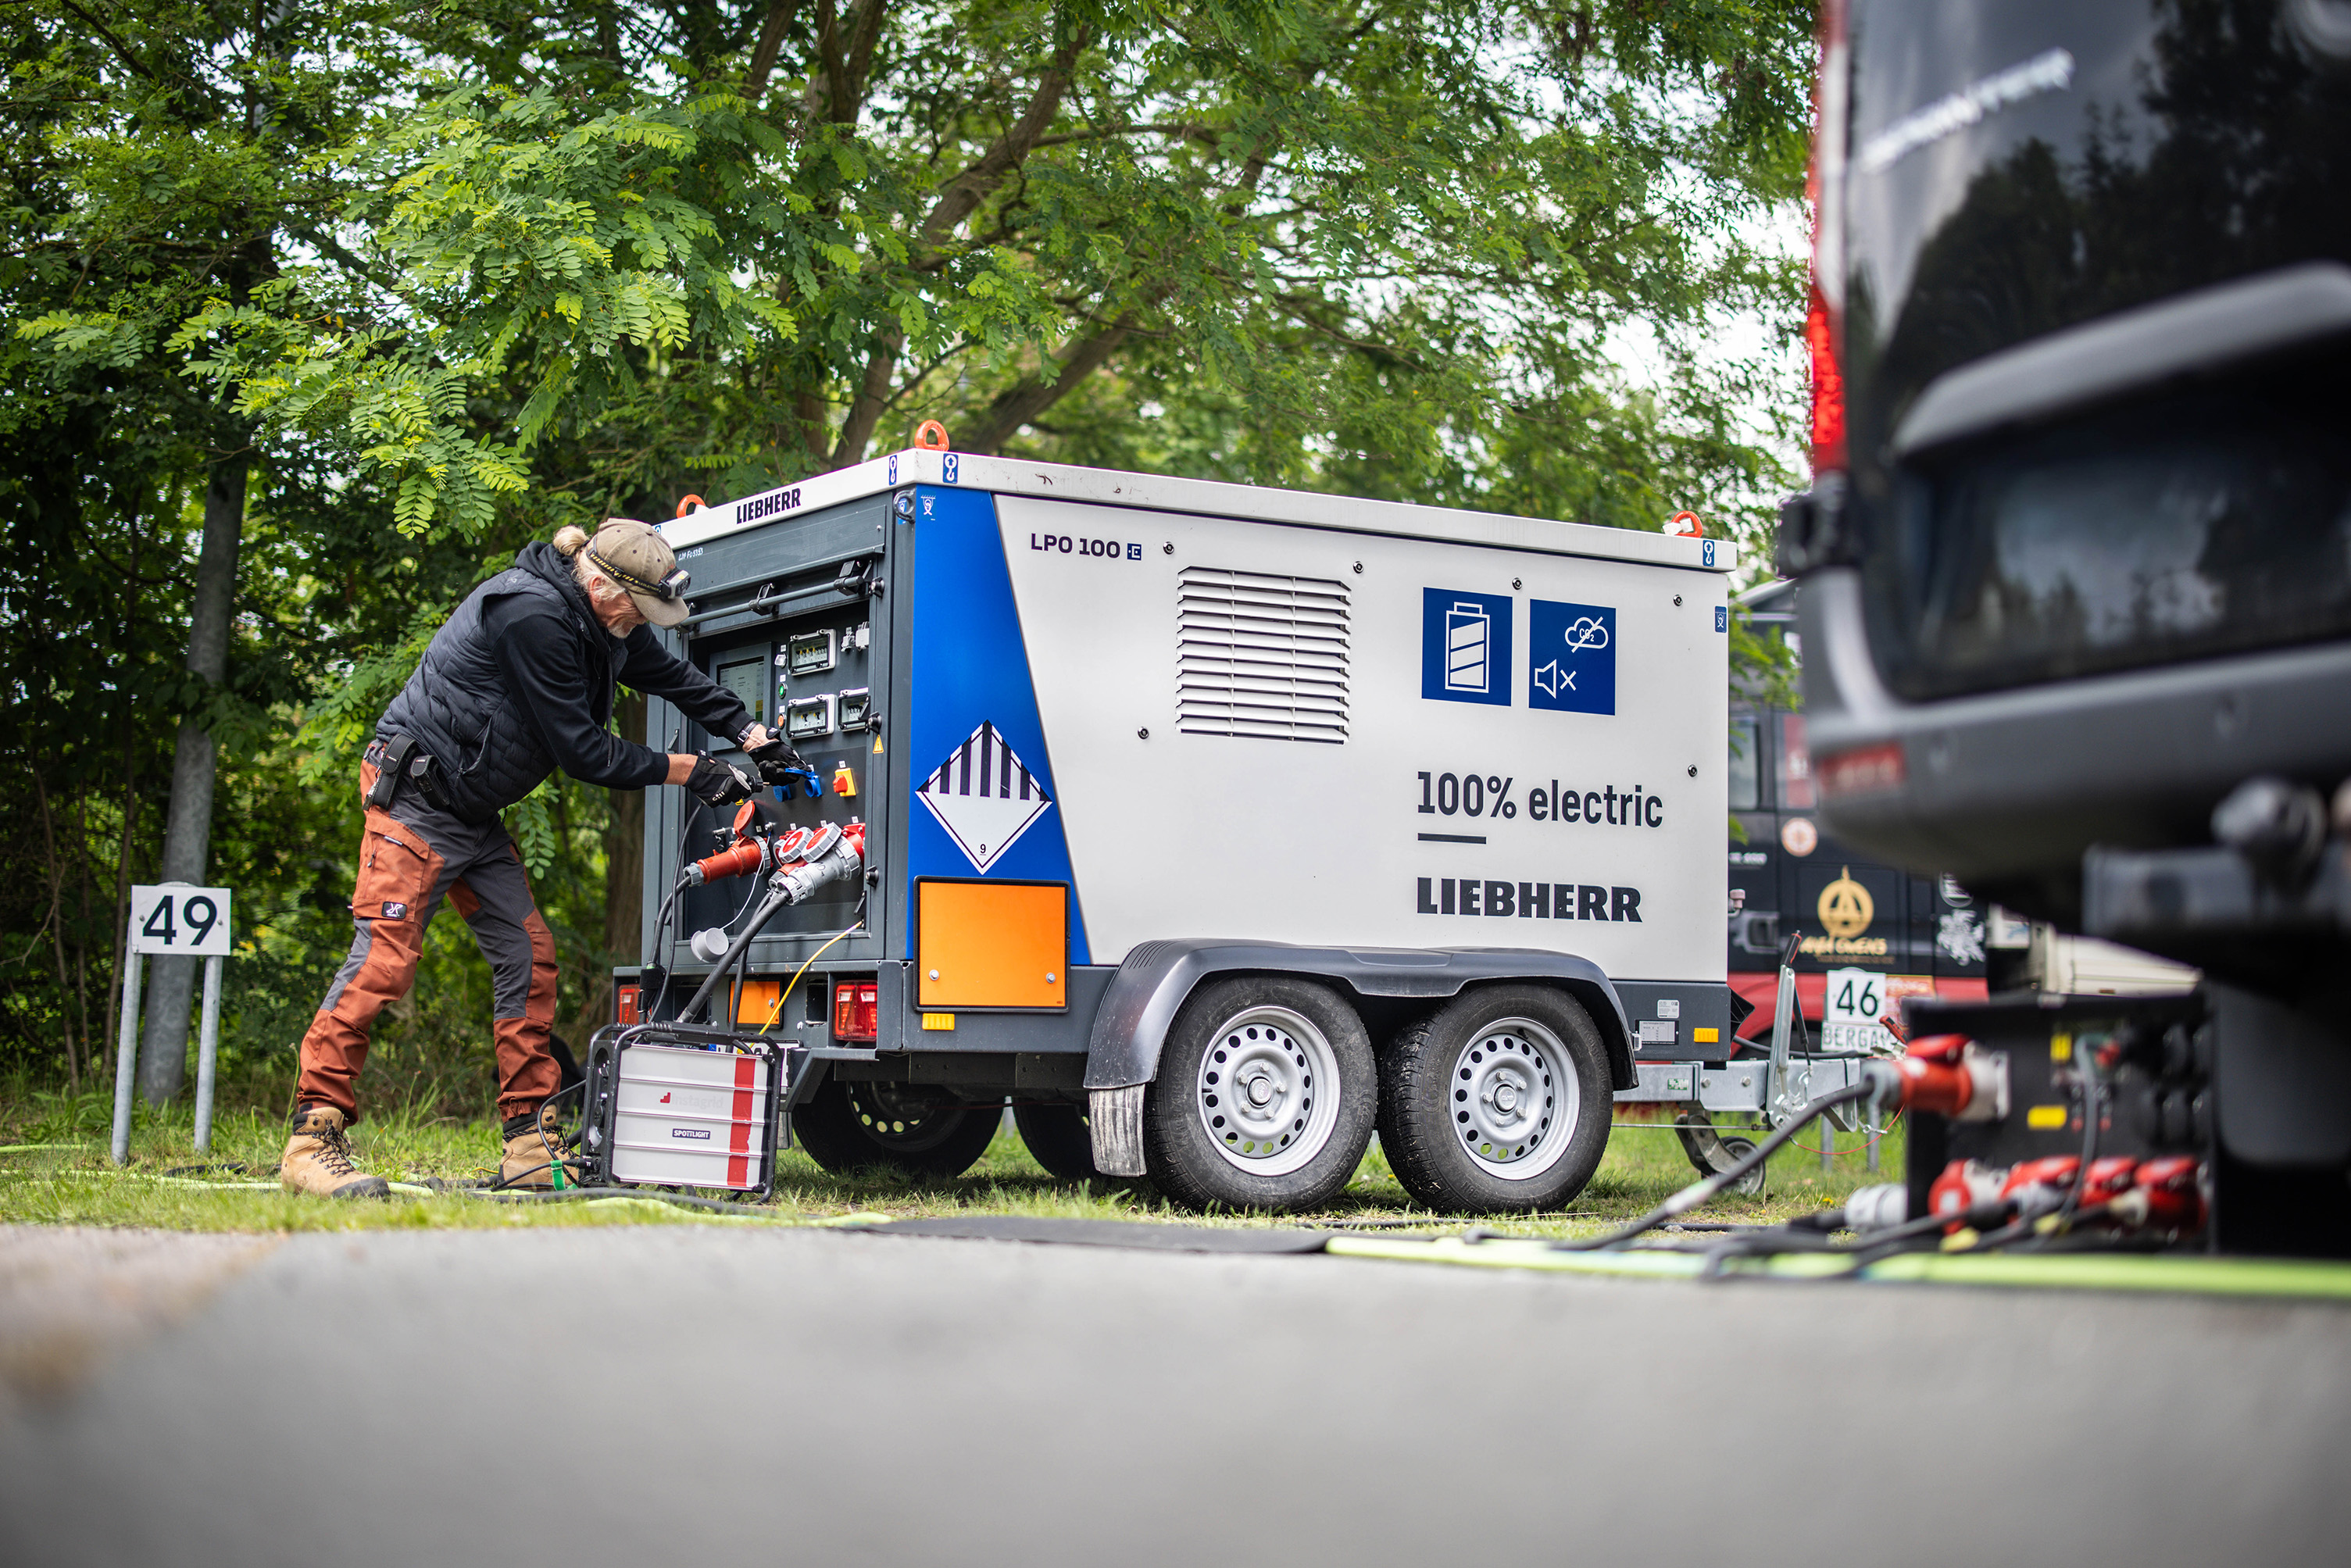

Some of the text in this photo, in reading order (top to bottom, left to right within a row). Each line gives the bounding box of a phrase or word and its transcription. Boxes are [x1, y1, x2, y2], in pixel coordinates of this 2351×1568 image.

[737, 488, 801, 524] LIEBHERR
[1031, 533, 1073, 553] LPO
[1079, 538, 1120, 559] 100
[1417, 770, 1663, 828] 100% electric
[980, 843, 987, 854] 9
[1417, 877, 1644, 923] LIEBHERR
[142, 895, 218, 946] 49
[1837, 980, 1878, 1017] 46
